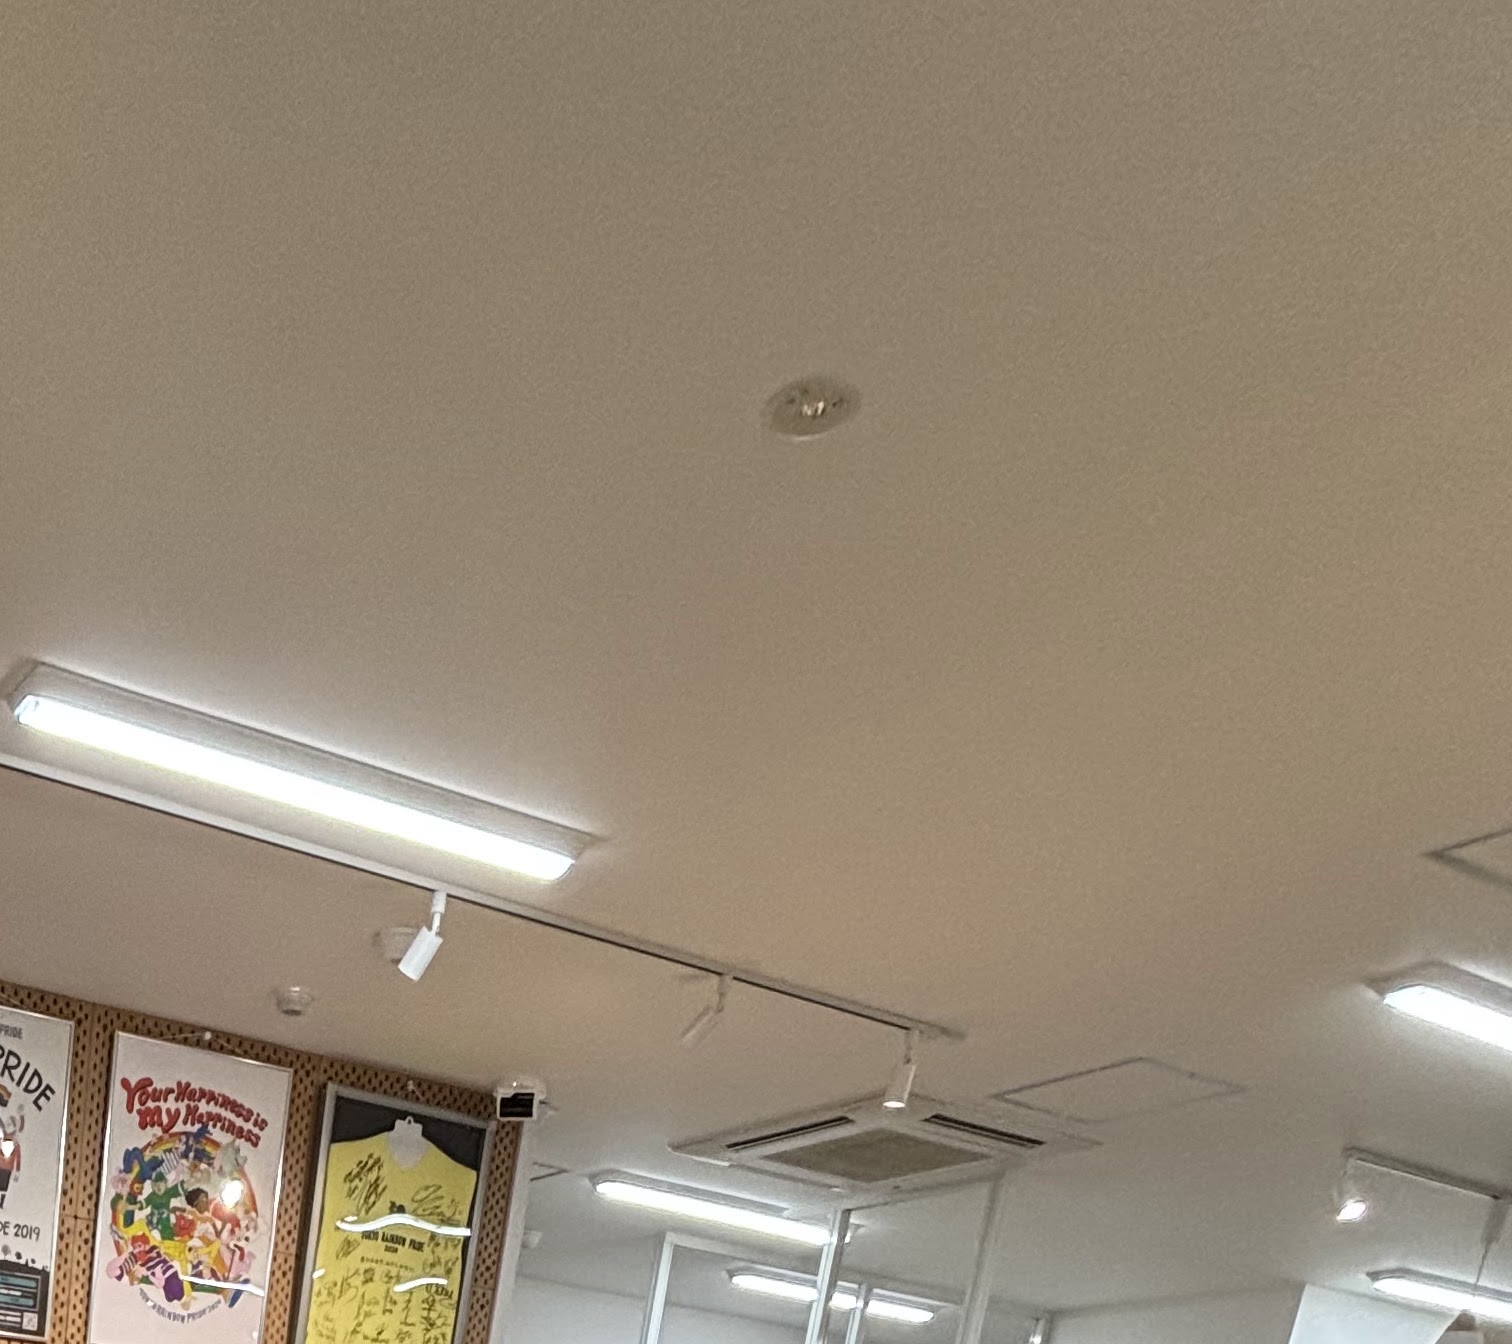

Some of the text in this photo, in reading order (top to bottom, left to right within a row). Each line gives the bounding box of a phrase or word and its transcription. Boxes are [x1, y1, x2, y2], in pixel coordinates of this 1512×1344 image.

[0, 1023, 23, 1039] PRIDE
[121, 1077, 175, 1114] Your
[254, 1112, 268, 1131] is
[13, 1224, 40, 1241] 2019
